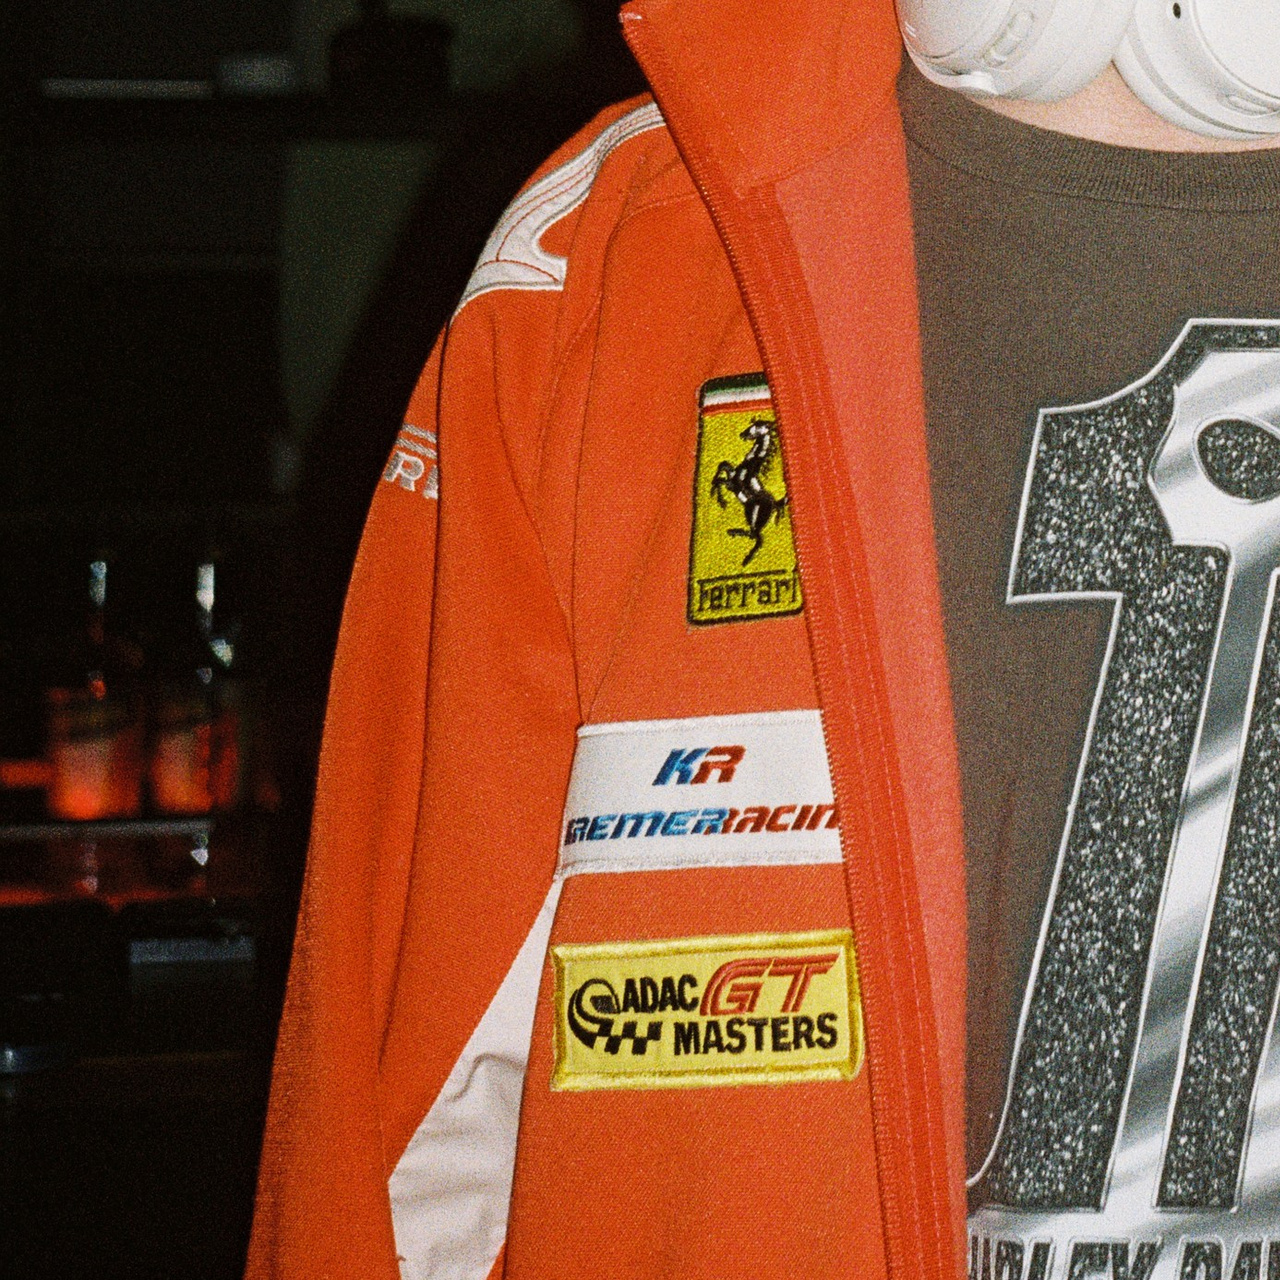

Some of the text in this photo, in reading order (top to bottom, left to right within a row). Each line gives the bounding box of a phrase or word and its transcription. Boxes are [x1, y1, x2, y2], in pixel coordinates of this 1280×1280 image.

[652, 744, 746, 786] KR
[622, 953, 842, 1016] ADAC GT
[674, 1012, 839, 1056] MASTERS
